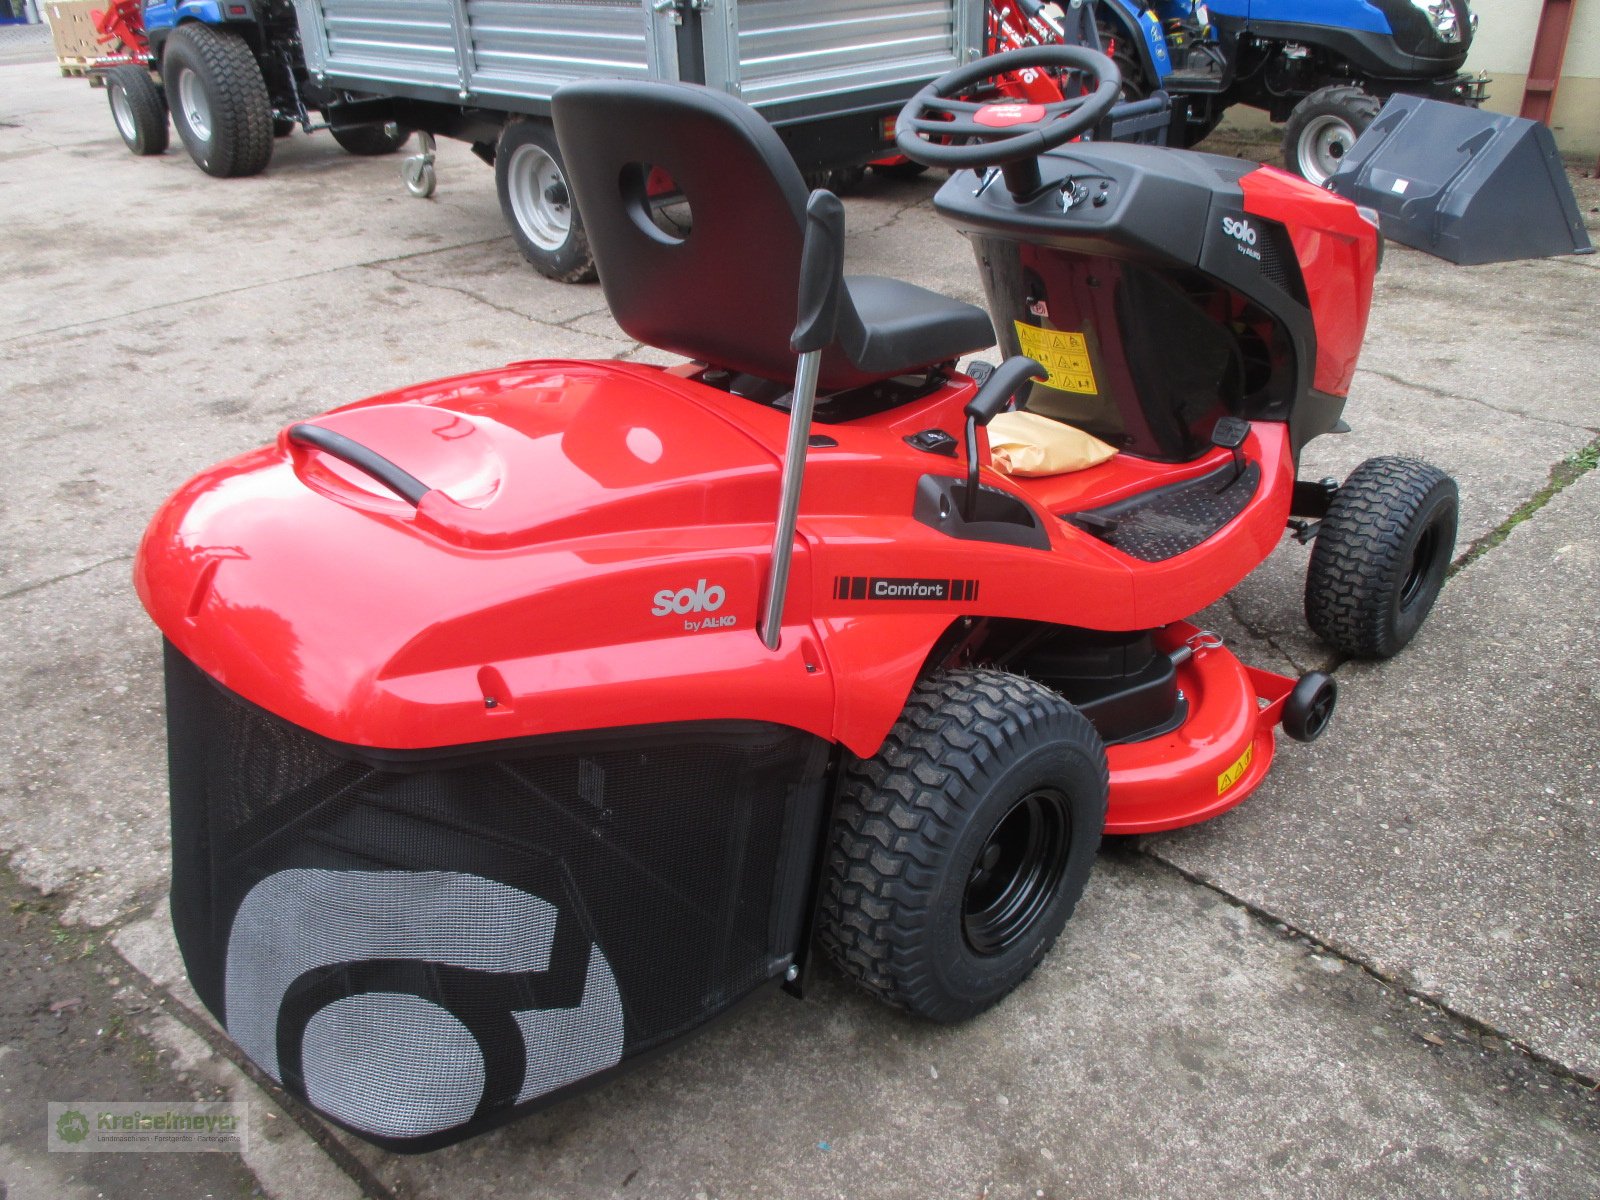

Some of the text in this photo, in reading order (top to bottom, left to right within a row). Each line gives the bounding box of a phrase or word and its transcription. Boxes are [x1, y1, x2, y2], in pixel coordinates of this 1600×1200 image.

[1223, 217, 1256, 245] solo
[651, 578, 726, 617] solo
[875, 581, 943, 596] Comfort
[684, 620, 701, 632] by
